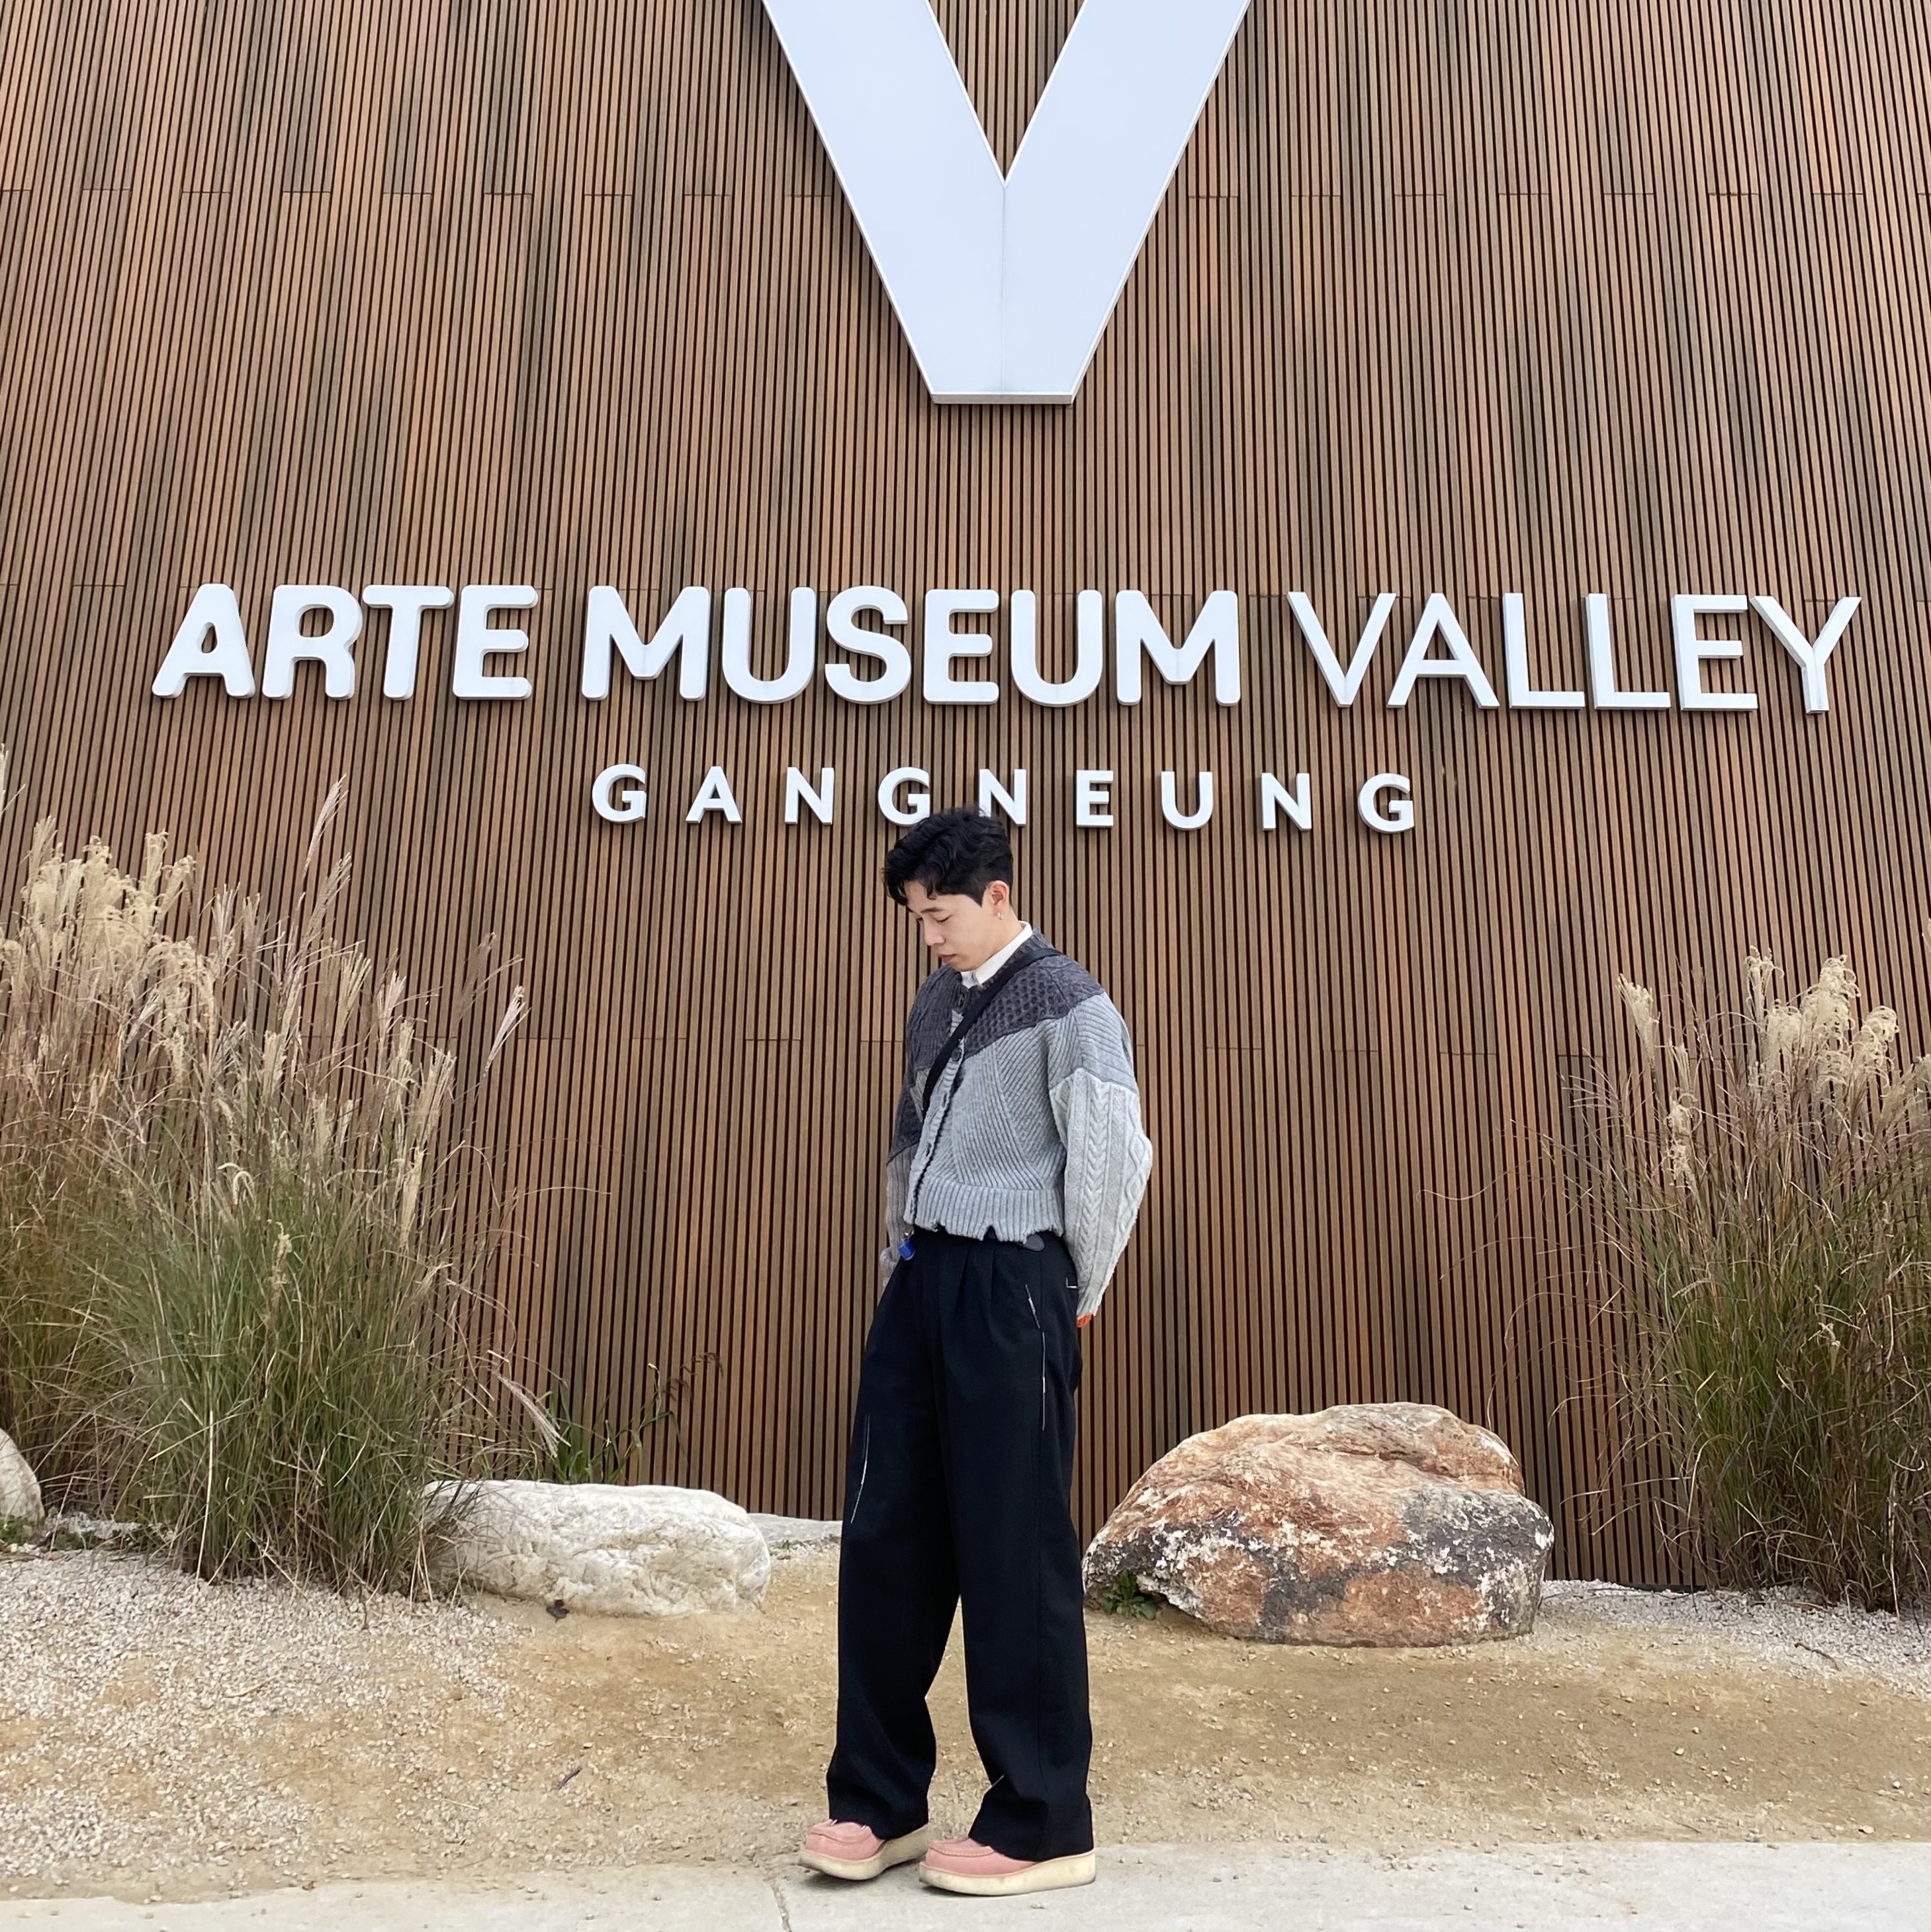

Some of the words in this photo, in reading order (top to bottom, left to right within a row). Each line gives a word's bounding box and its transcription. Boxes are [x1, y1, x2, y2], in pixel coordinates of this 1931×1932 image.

[152, 582, 539, 700] ARTE
[580, 586, 1241, 706] MUSEUM
[1287, 591, 1861, 715] VALLEY
[592, 764, 1415, 833] GANGNEUNG
